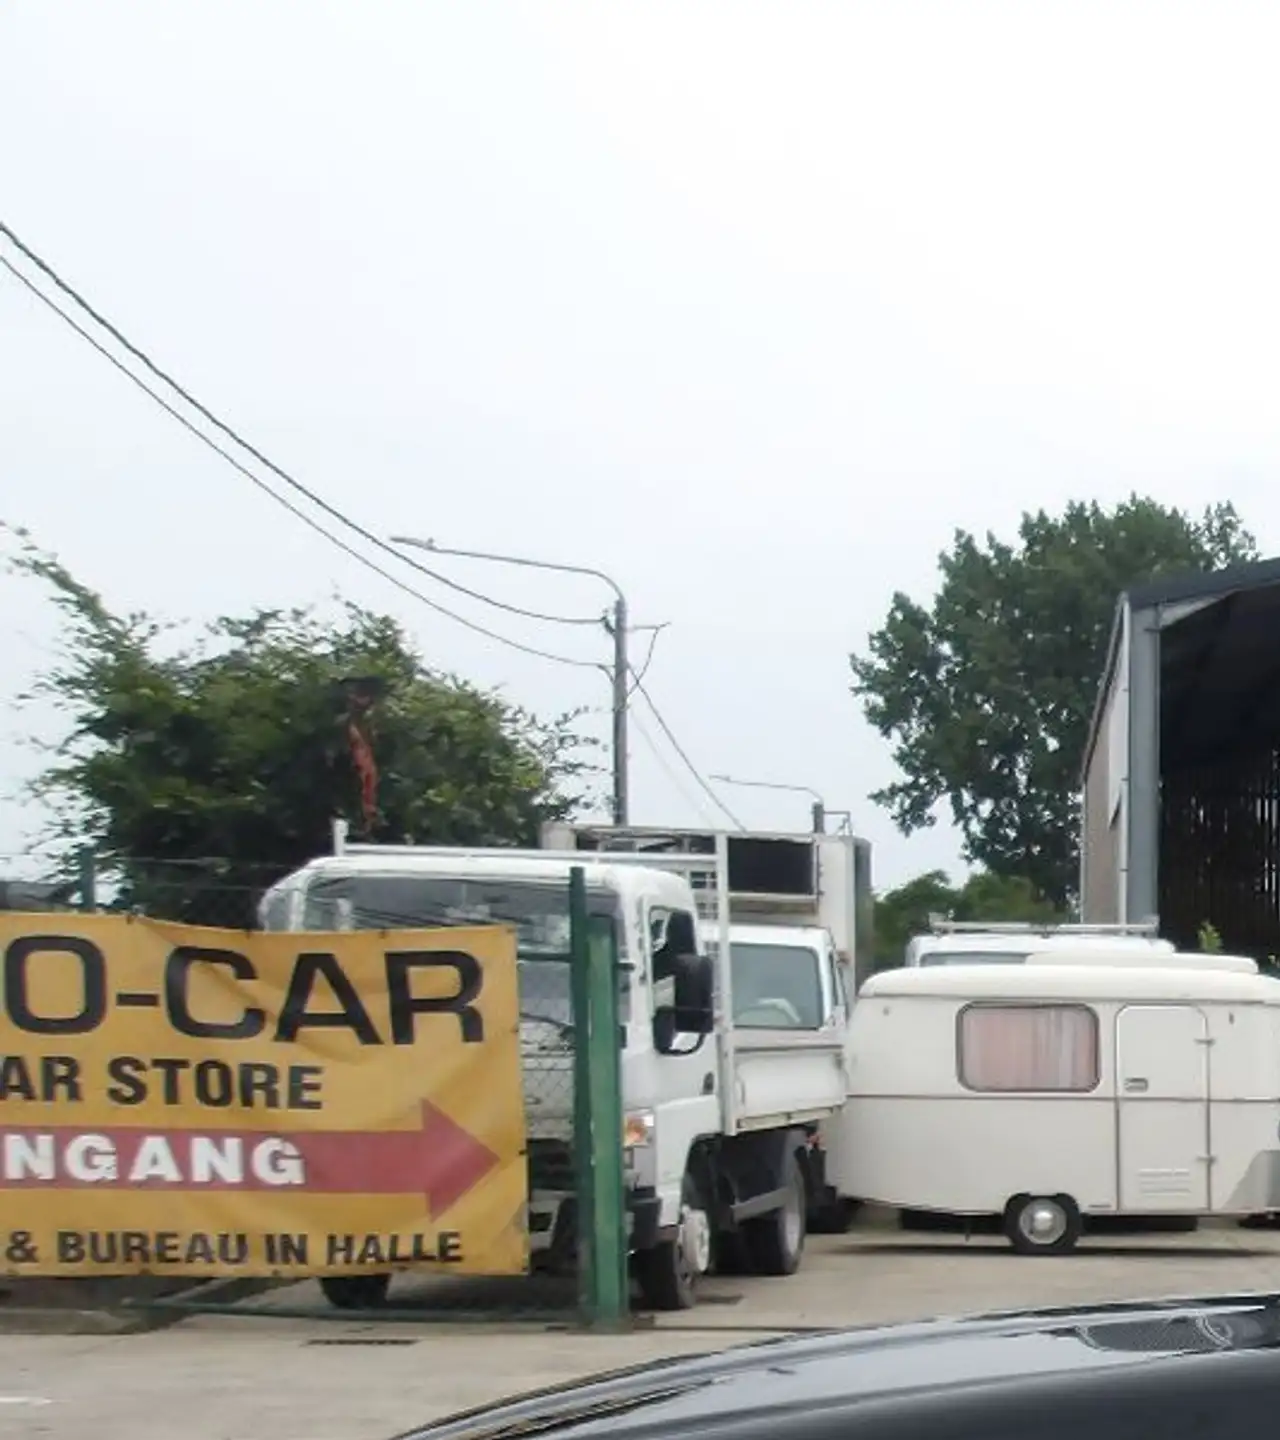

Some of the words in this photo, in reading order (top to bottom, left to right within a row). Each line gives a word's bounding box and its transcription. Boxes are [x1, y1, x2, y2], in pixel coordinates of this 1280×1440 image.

[107, 1055, 324, 1110] STORE
[6, 1230, 39, 1264] &
[57, 1230, 248, 1266] BUREAU
[265, 1233, 308, 1266] IN
[327, 1231, 464, 1266] HALLE
